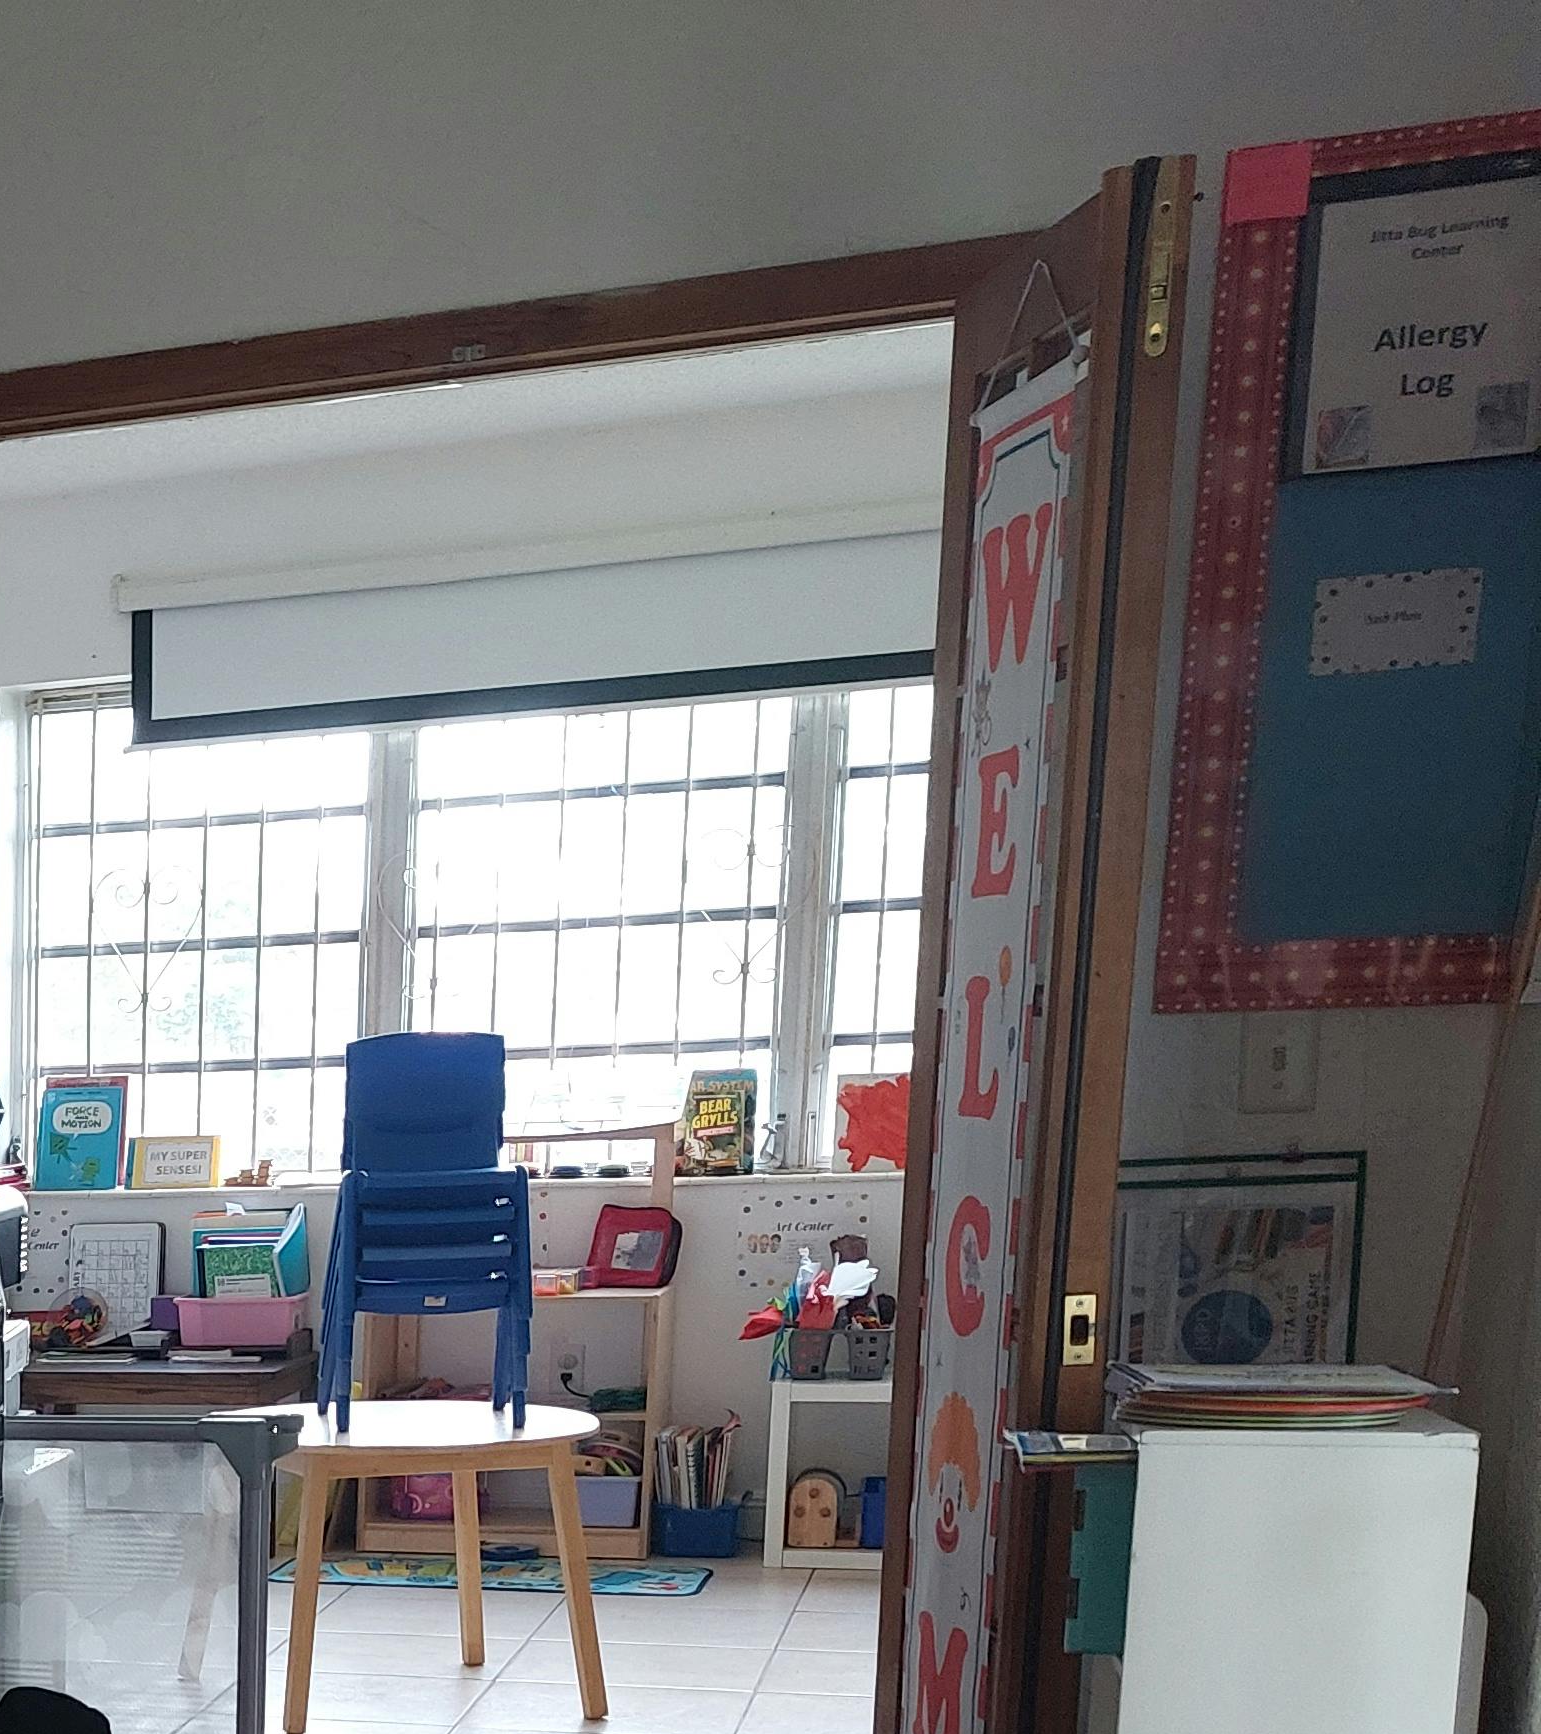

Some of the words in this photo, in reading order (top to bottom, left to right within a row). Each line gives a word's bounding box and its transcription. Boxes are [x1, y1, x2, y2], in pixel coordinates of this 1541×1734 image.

[1408, 225, 1437, 239] Bug
[1441, 215, 1510, 234] Learning
[1374, 322, 1488, 352] Allergy
[1401, 372, 1455, 398] Log
[65, 1107, 99, 1116] FORCE
[700, 1098, 731, 1114] BEAR
[61, 1119, 101, 1128] MOTION
[692, 1111, 738, 1128] GRYLLS
[150, 1151, 168, 1161] MY
[169, 1151, 207, 1160] SUPER
[776, 1222, 792, 1231] Art
[795, 1222, 834, 1231] Center
